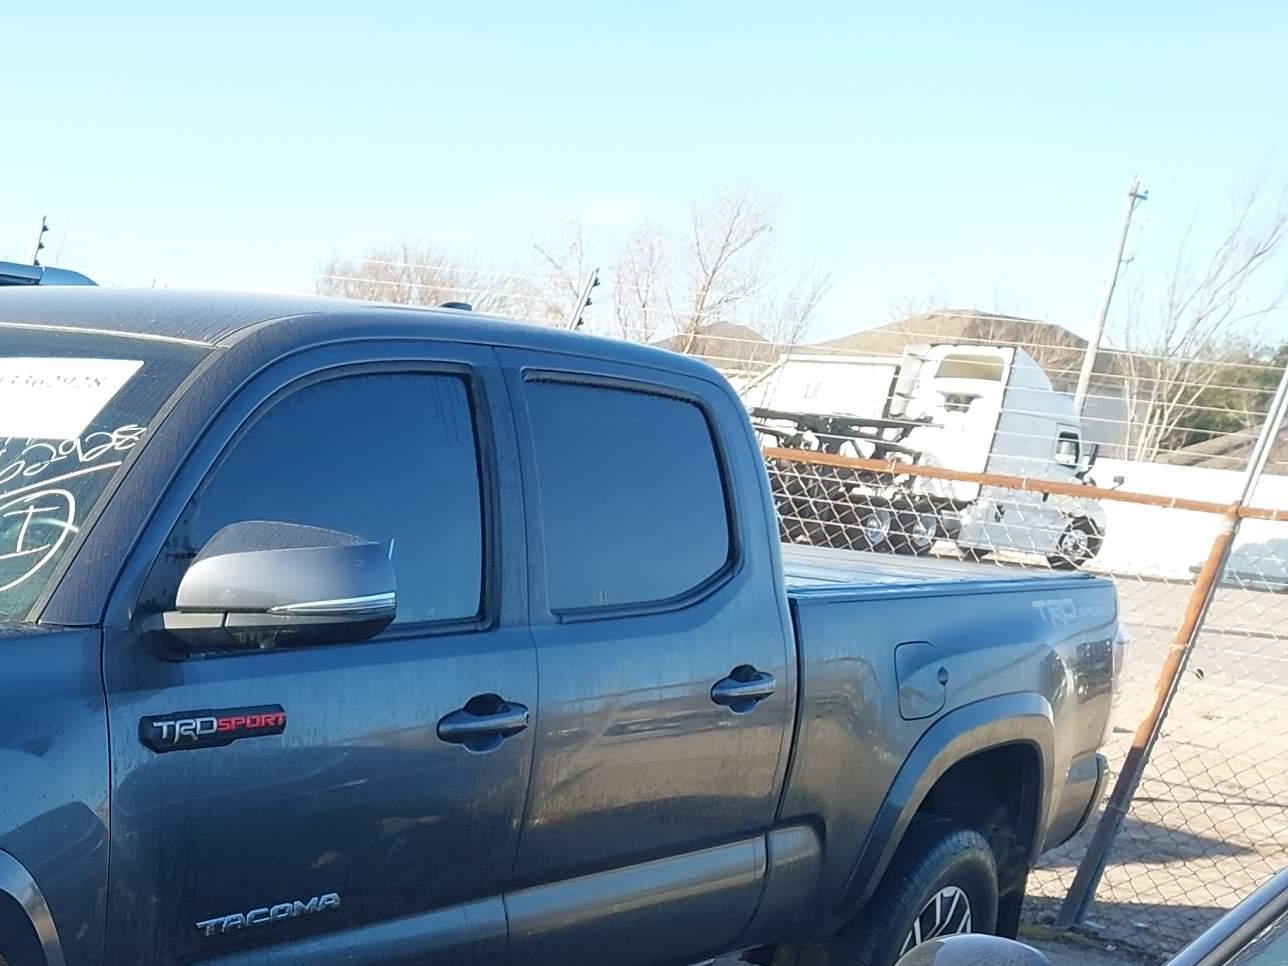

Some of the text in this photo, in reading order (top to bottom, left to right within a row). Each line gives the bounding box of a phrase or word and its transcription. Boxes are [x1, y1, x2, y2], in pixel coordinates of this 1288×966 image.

[1032, 598, 1078, 627] TRD
[152, 712, 286, 744] TRD SPORT
[195, 892, 341, 937] TACOMA
